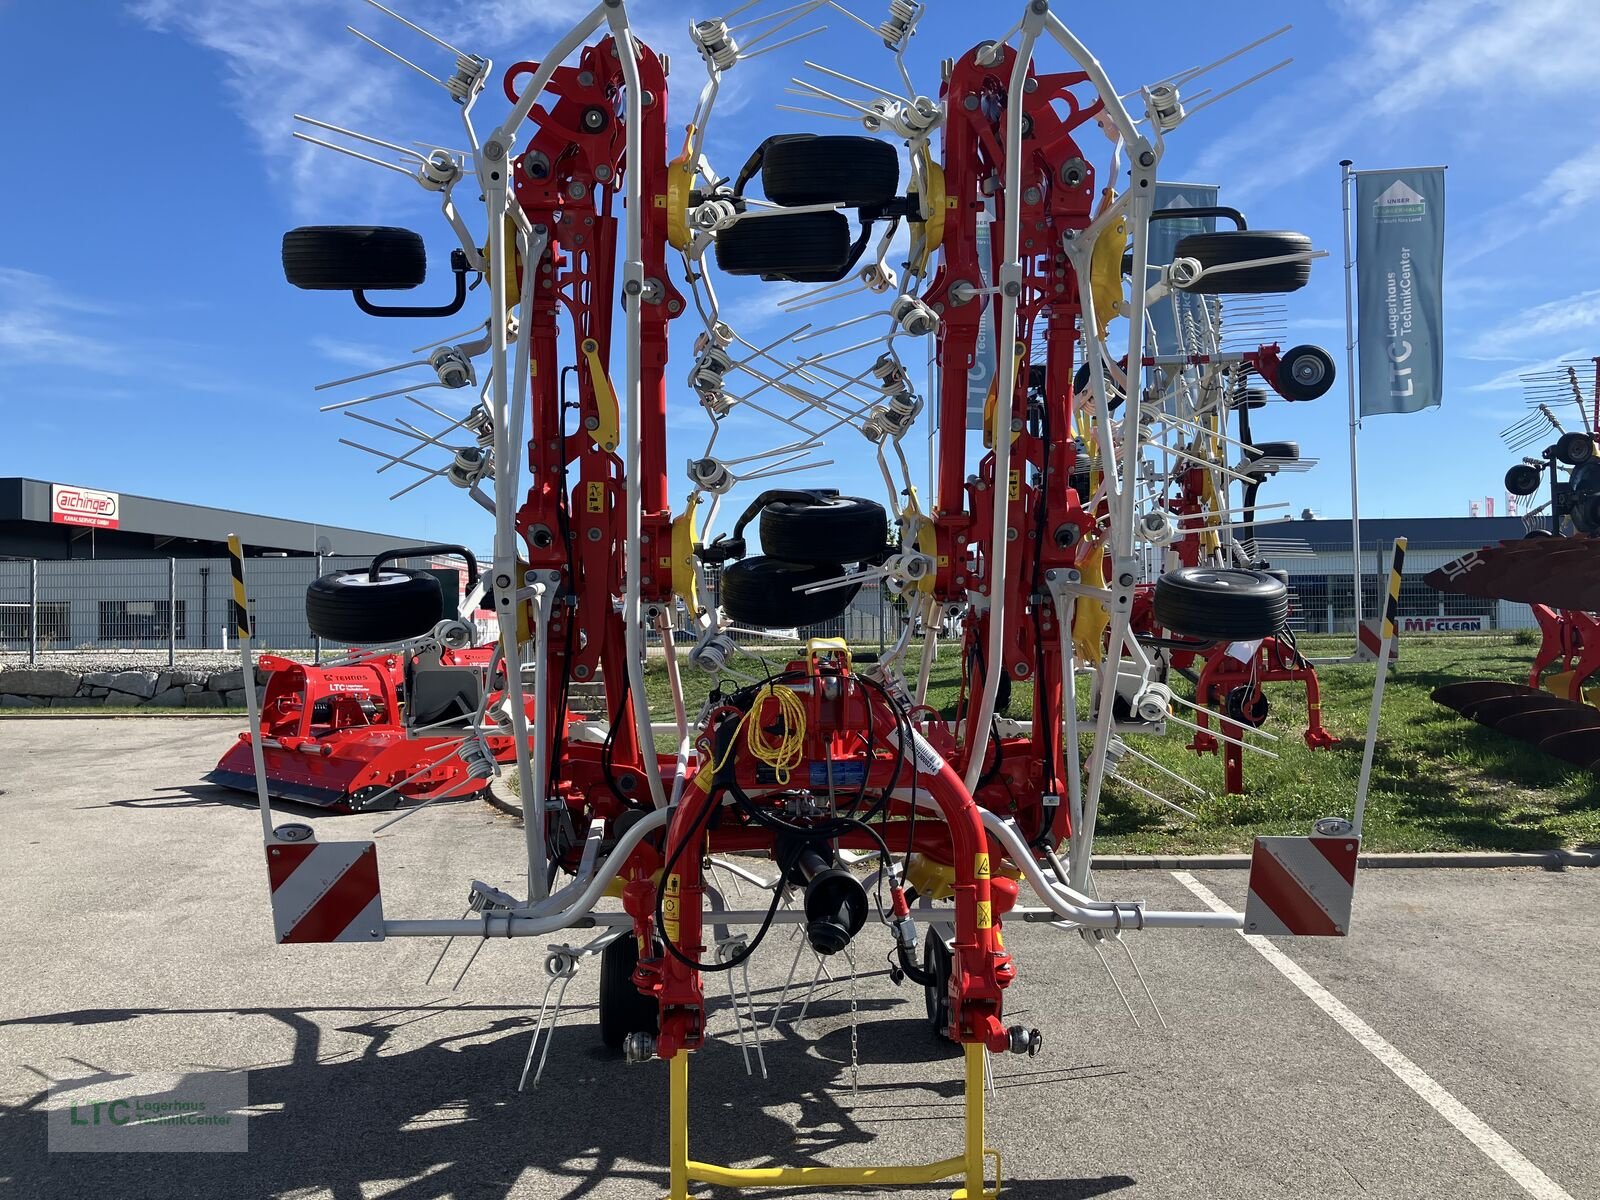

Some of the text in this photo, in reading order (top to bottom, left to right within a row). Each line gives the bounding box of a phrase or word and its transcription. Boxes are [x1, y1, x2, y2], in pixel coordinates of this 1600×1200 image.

[1399, 247, 1412, 337] TechnikCenter
[1385, 272, 1414, 397] LTC Lagerhaus
[60, 493, 111, 513] aichinger
[1404, 618, 1481, 631] MF CLEAN
[329, 683, 346, 691] LTC
